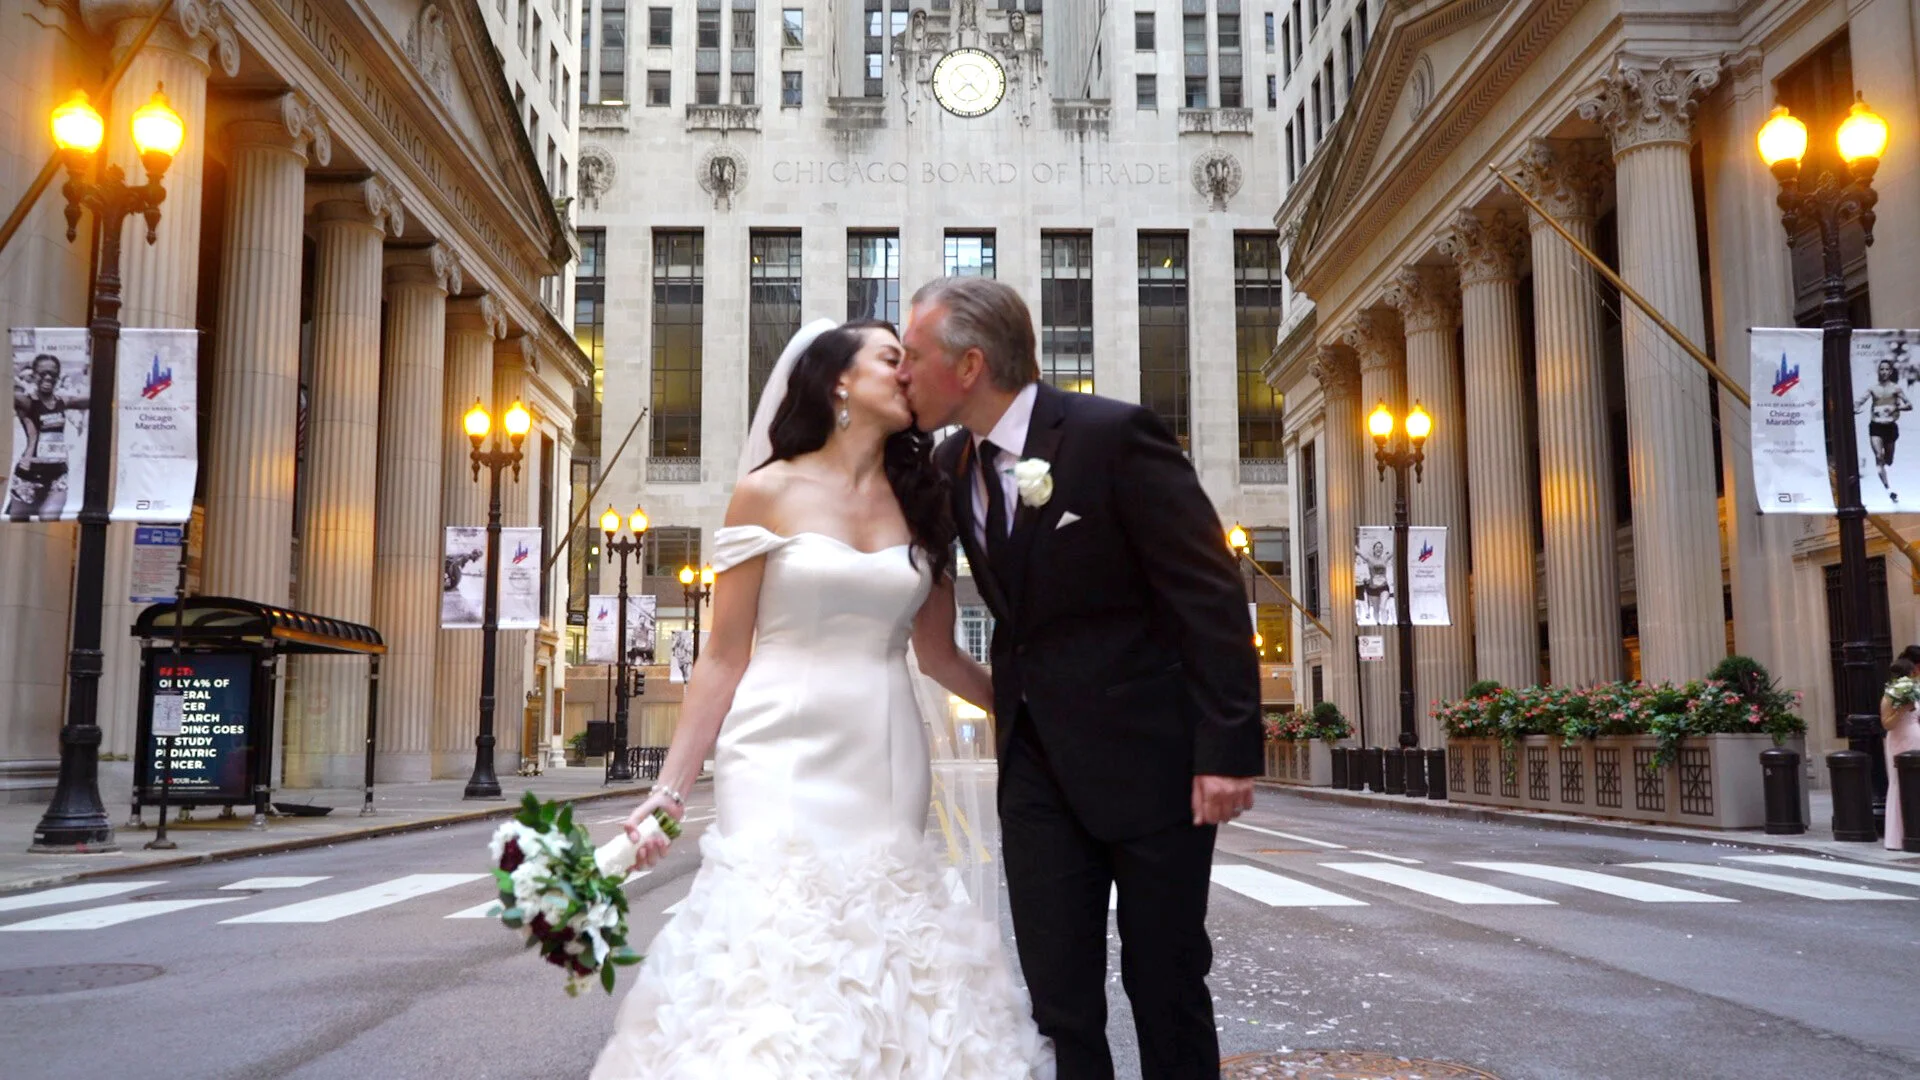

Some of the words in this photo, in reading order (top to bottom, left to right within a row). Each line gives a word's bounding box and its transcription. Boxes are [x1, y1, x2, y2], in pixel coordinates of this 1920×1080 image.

[365, 77, 443, 188] FINANCIAL
[773, 161, 909, 185] CHICAGO
[922, 162, 1017, 185] BOARD
[1032, 162, 1069, 184] OF
[1080, 162, 1172, 185] TRADE
[139, 413, 173, 423] Chicago
[1769, 410, 1801, 420] Chicago
[134, 422, 178, 431] Marathon
[1765, 418, 1805, 426] Marathon
[192, 679, 212, 688] 4%
[213, 679, 230, 688] OF
[181, 713, 220, 723] EARCH
[212, 725, 245, 735] GOES
[174, 737, 213, 747] STUDY
[153, 760, 206, 770] CNCER.
